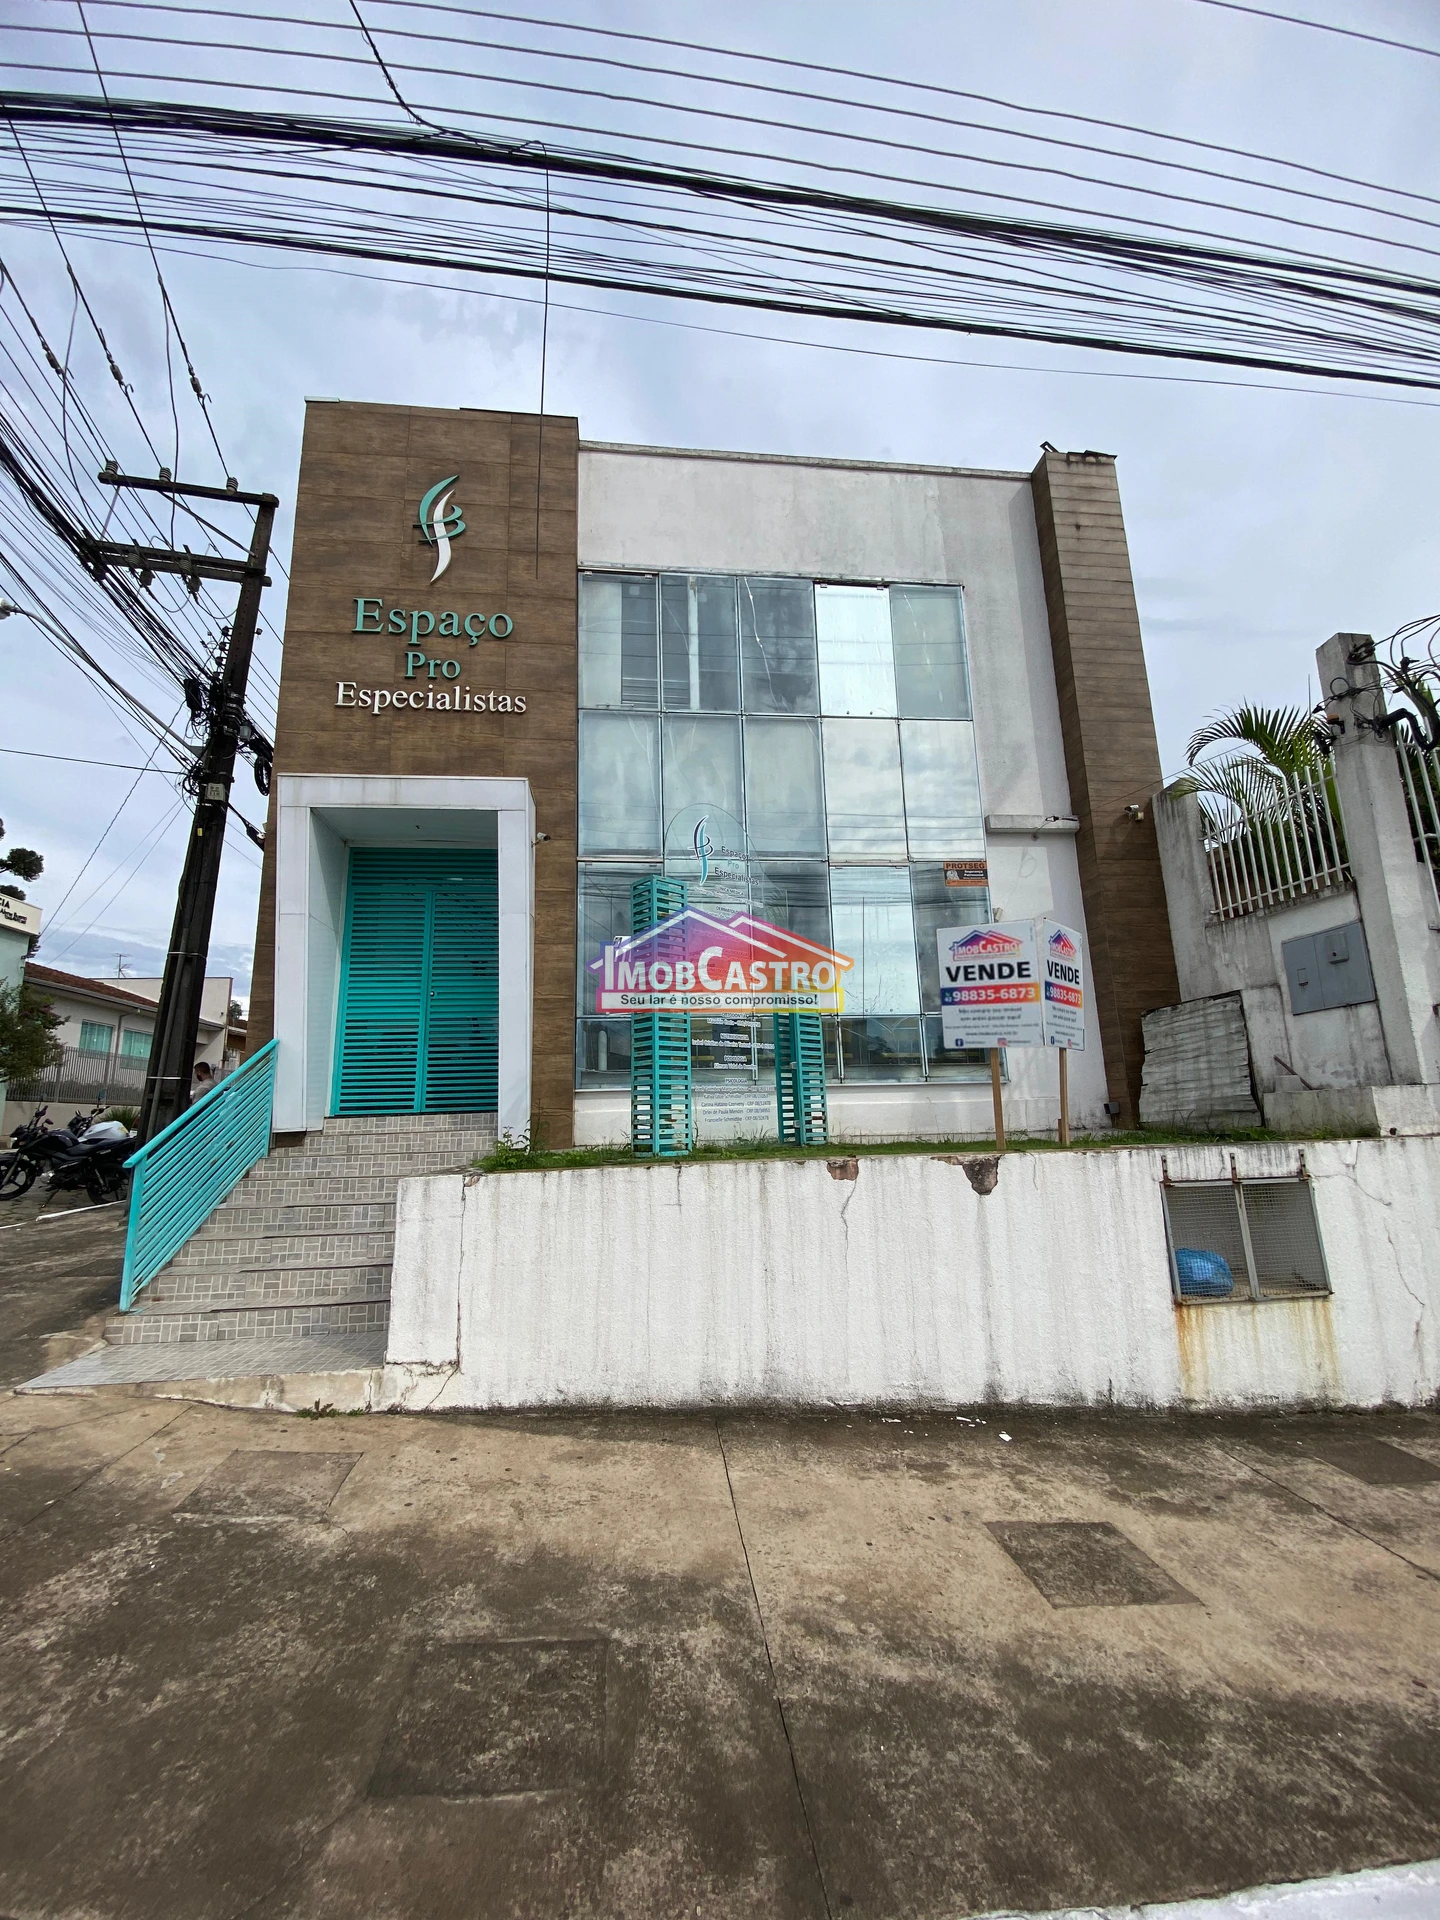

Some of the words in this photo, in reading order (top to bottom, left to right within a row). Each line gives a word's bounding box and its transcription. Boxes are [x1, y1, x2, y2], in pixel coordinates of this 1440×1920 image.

[352, 597, 513, 646] Espaço
[404, 651, 461, 679] Pro
[334, 681, 527, 715] Especialistas
[727, 860, 740, 869] Pro
[714, 866, 759, 886] Especialistas
[946, 961, 1031, 983] VENDE
[1047, 959, 1080, 985] VENDE
[952, 987, 1035, 1002] 98835-6873
[1050, 986, 1081, 1004] 98835-6873
